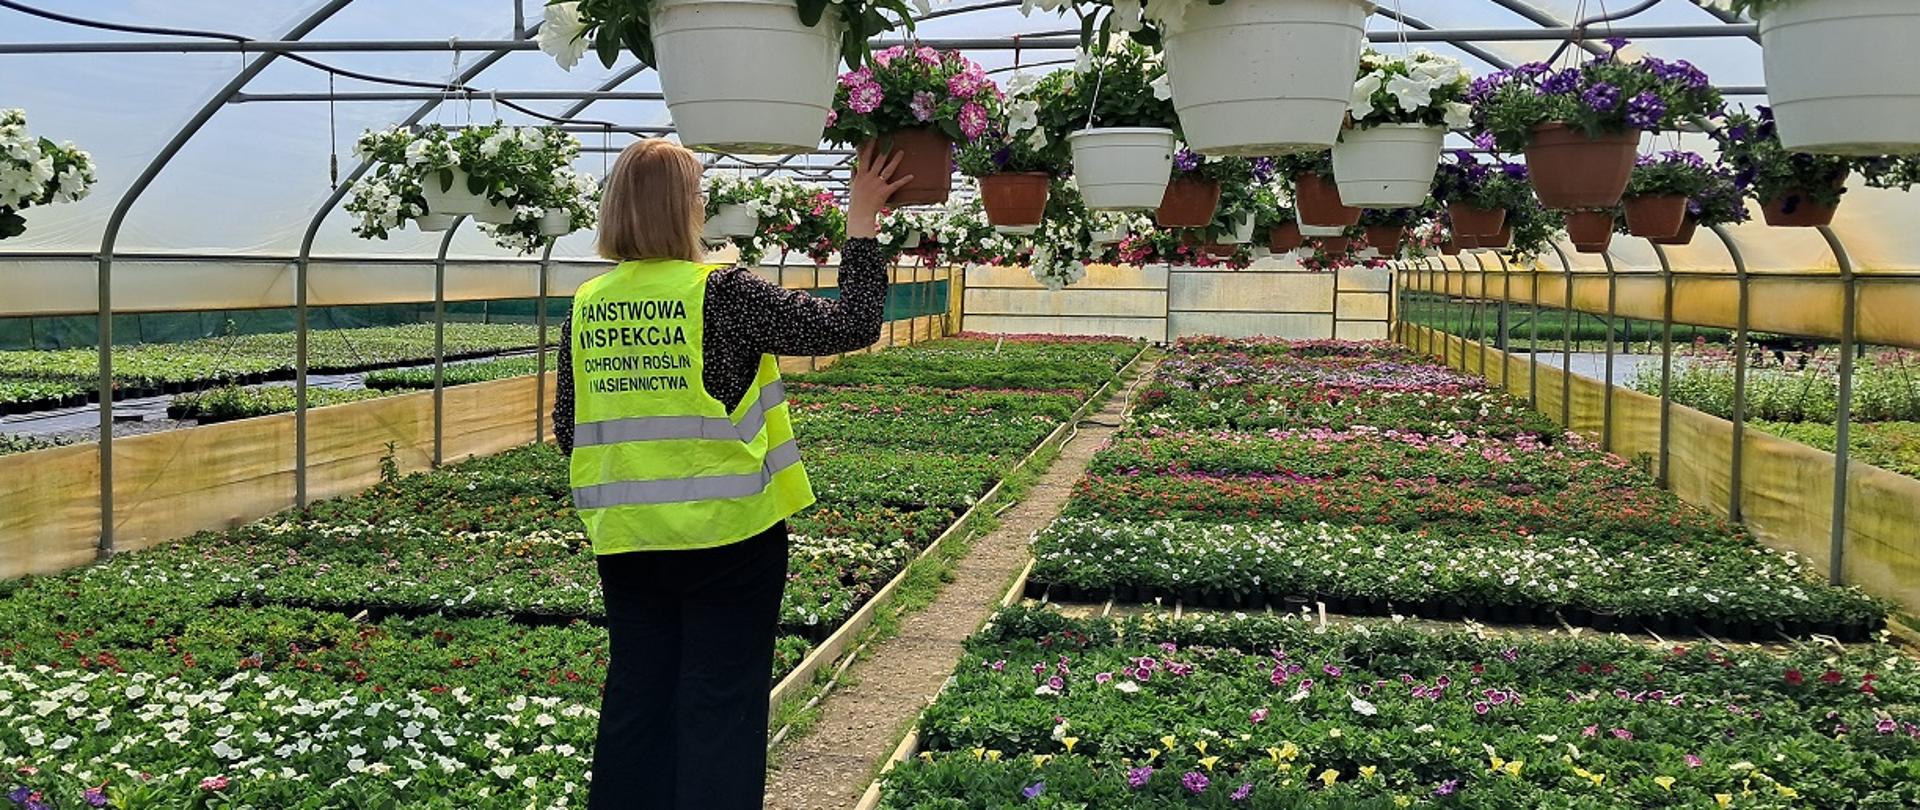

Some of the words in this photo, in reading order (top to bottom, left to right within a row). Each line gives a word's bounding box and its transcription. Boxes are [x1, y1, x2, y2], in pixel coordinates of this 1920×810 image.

[581, 297, 687, 324] PAŃSTWOWA
[580, 326, 686, 349] INSPEKCJA
[585, 356, 639, 373] OCHRONY
[643, 351, 691, 370] ROŚLIN
[593, 376, 688, 393] NASIENNICTWA
